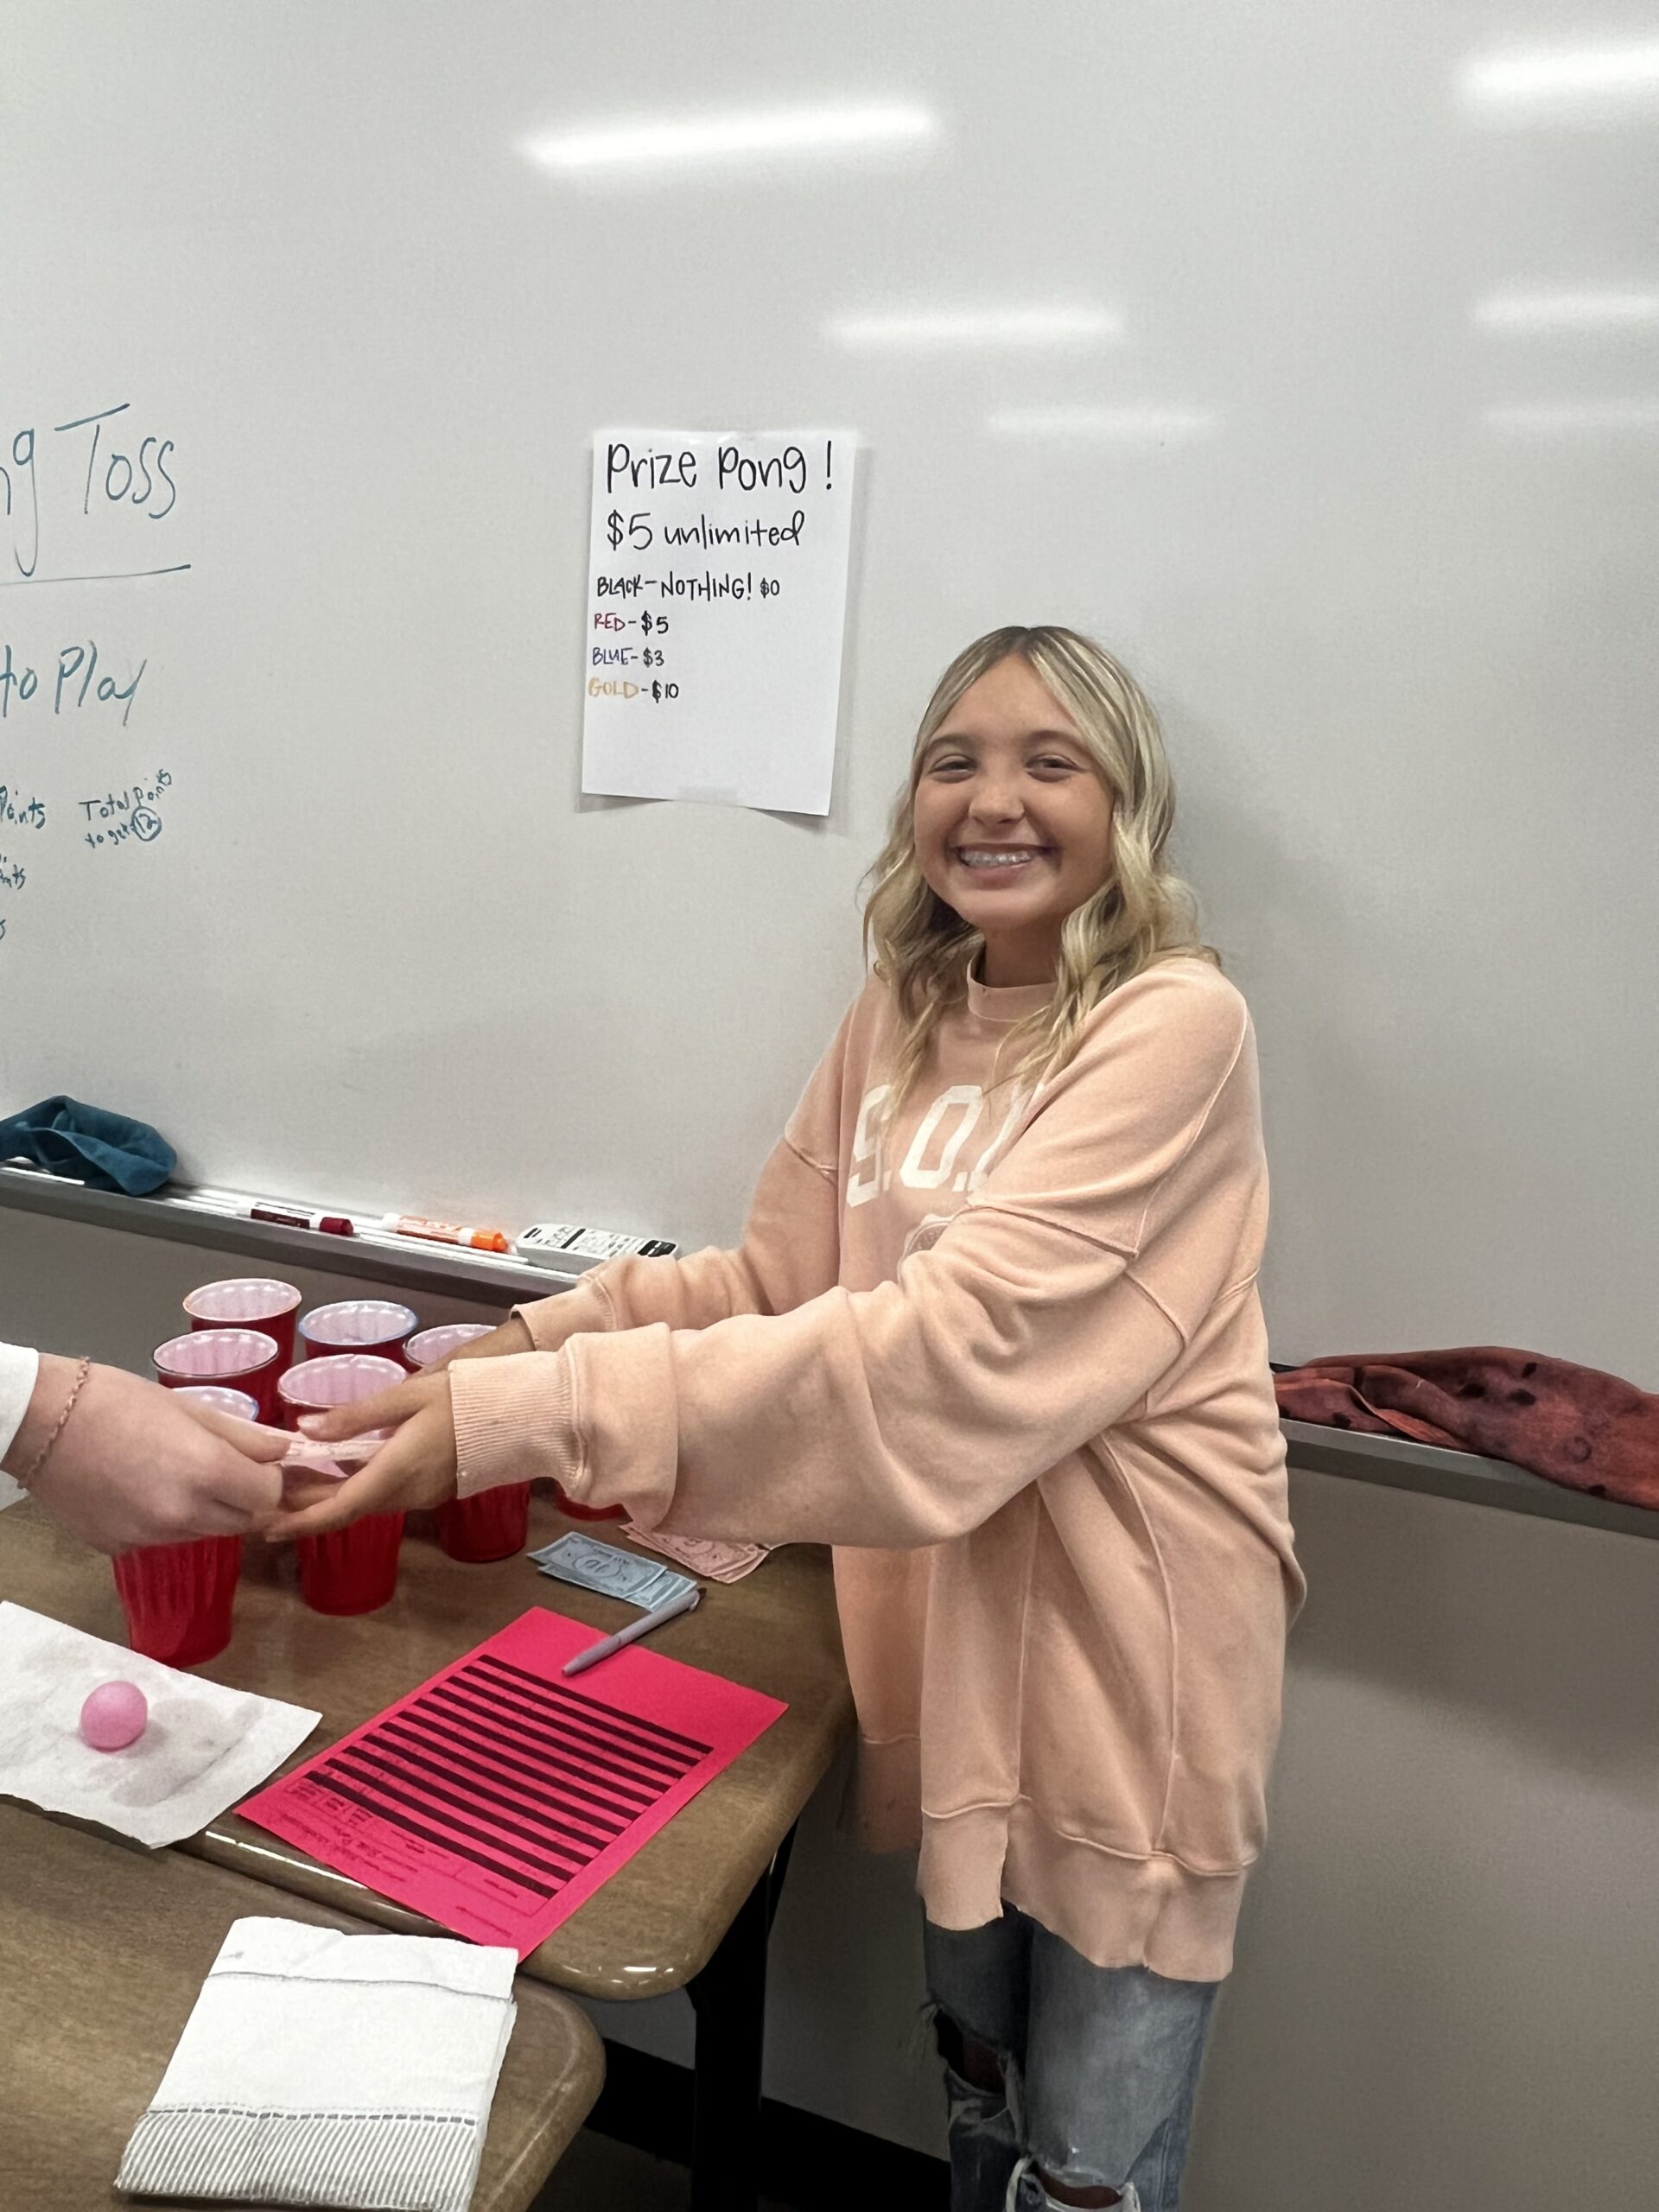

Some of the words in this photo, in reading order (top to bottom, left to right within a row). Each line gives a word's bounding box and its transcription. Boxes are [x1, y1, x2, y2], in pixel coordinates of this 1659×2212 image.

[54, 403, 176, 519] Toss
[607, 442, 697, 493] Prize
[718, 446, 807, 493] Pong
[607, 509, 653, 551] $5
[664, 510, 805, 550] unlimited
[760, 577, 780, 599] $0
[0, 645, 38, 718] to
[54, 639, 148, 727] Play
[78, 791, 130, 821] Total
[132, 768, 172, 807] Points
